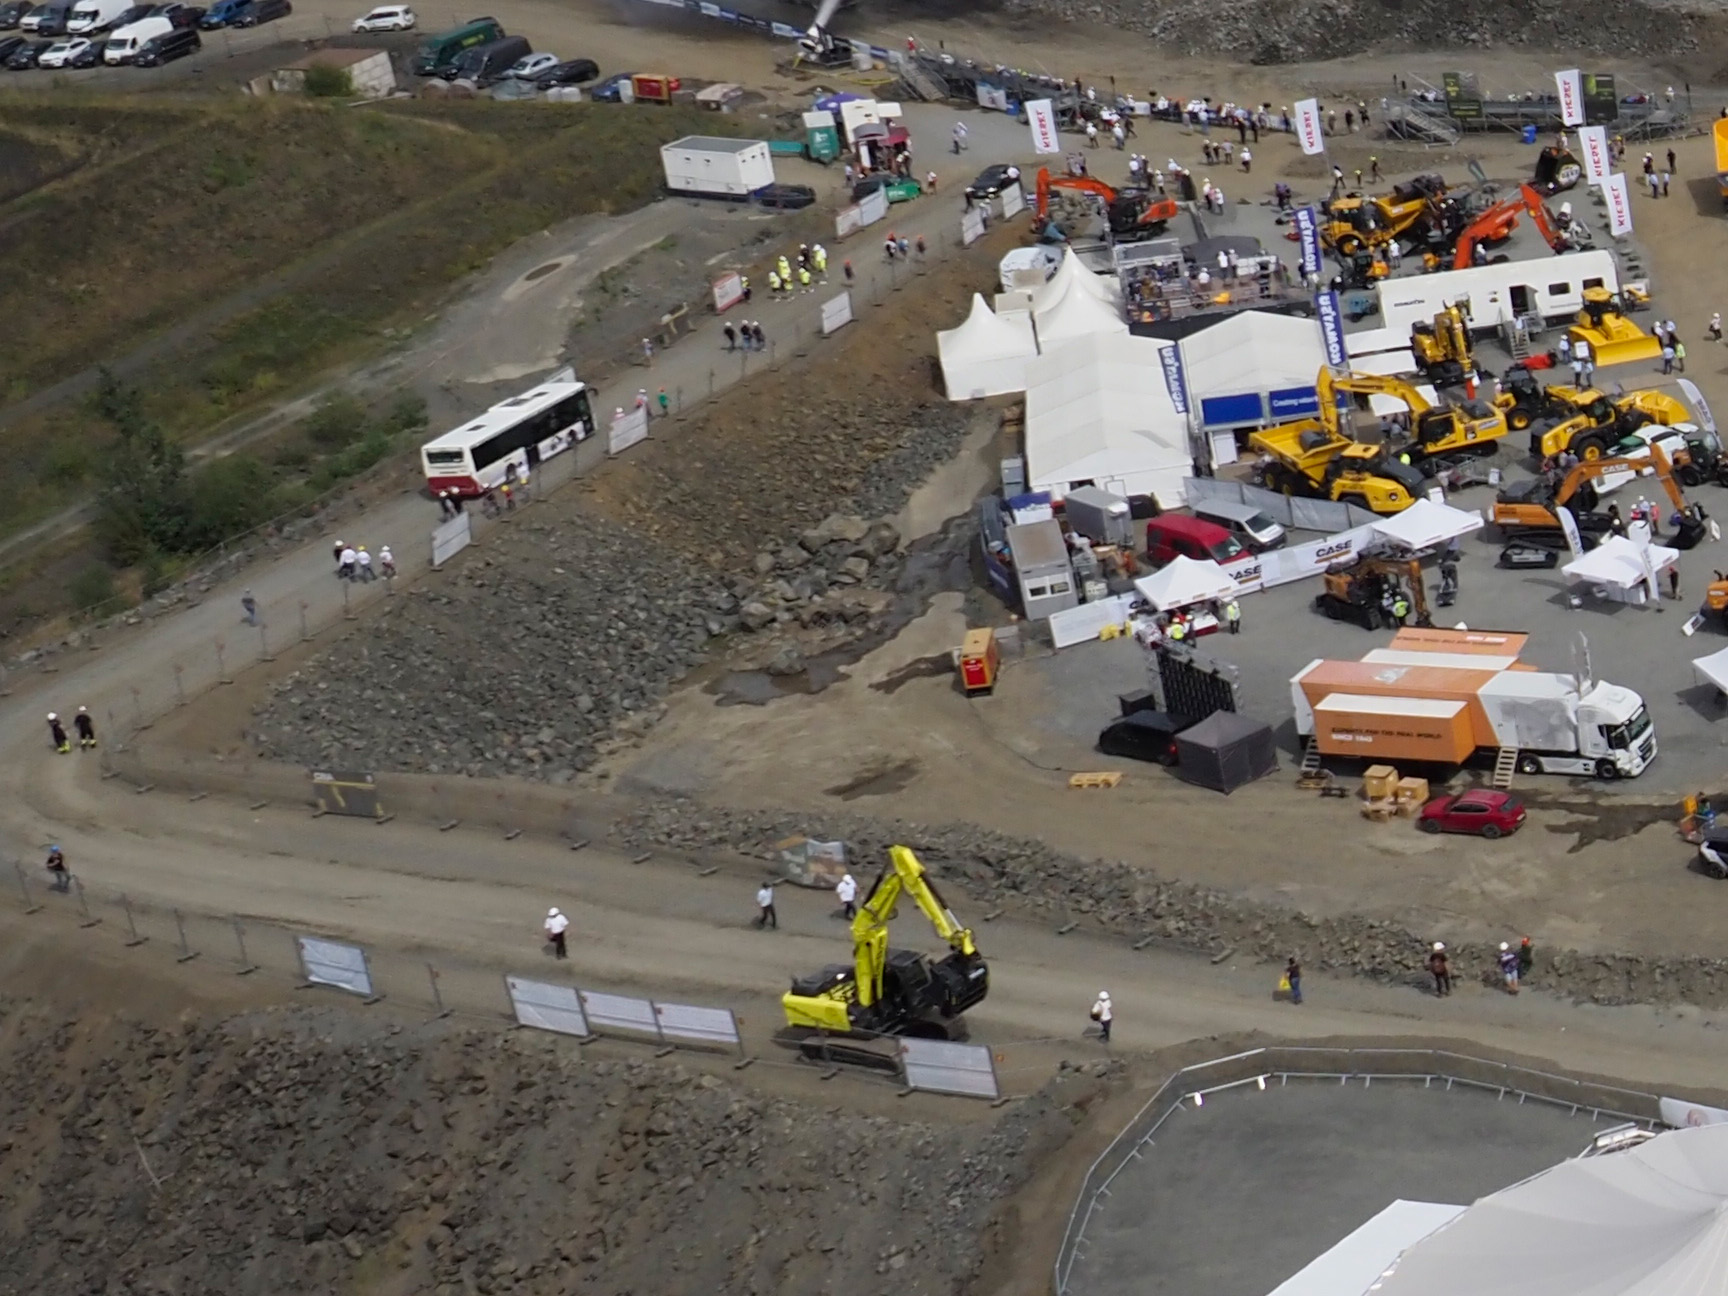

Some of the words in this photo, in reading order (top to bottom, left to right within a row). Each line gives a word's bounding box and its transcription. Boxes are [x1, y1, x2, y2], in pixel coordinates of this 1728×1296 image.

[1602, 463, 1629, 474] CASE
[1316, 542, 1353, 559] CASE
[1229, 563, 1263, 580] ASE
